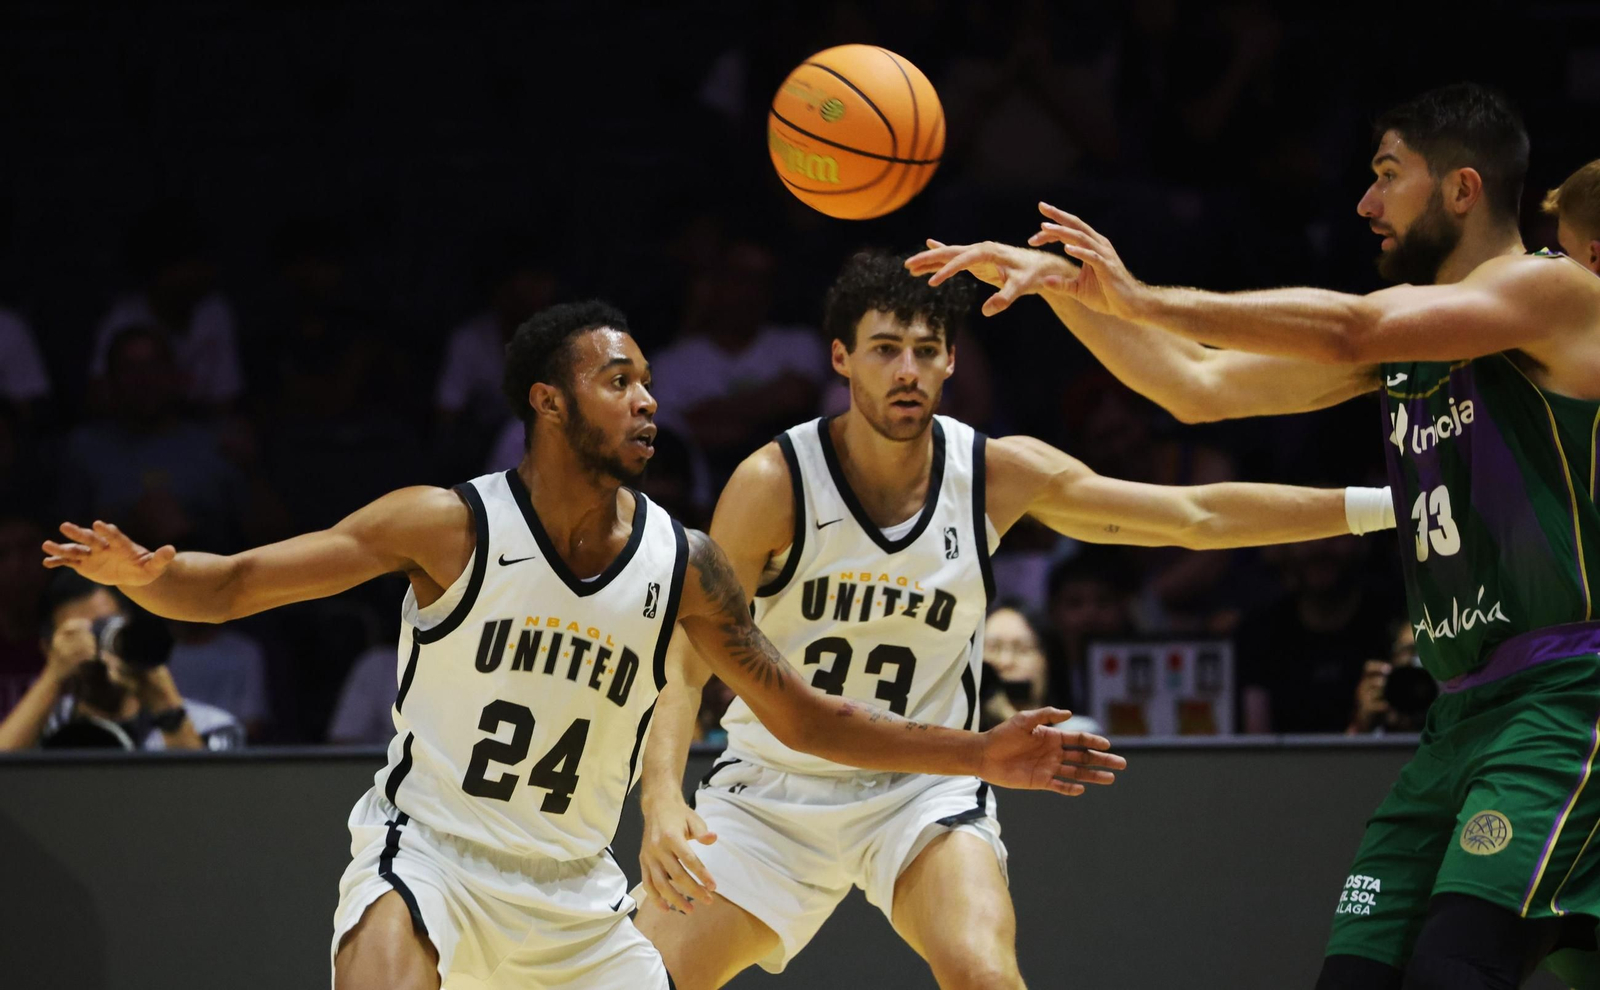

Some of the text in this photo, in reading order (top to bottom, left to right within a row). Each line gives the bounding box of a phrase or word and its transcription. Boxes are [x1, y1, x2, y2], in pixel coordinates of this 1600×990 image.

[801, 575, 957, 632] UNITED
[840, 572, 925, 592] NBAGL
[525, 616, 615, 647] NBAGL
[474, 617, 641, 708] UNITED
[804, 637, 917, 717] 33
[462, 699, 591, 815] 24
[1343, 874, 1381, 893] OSTA
[1350, 889, 1377, 906] SOL
